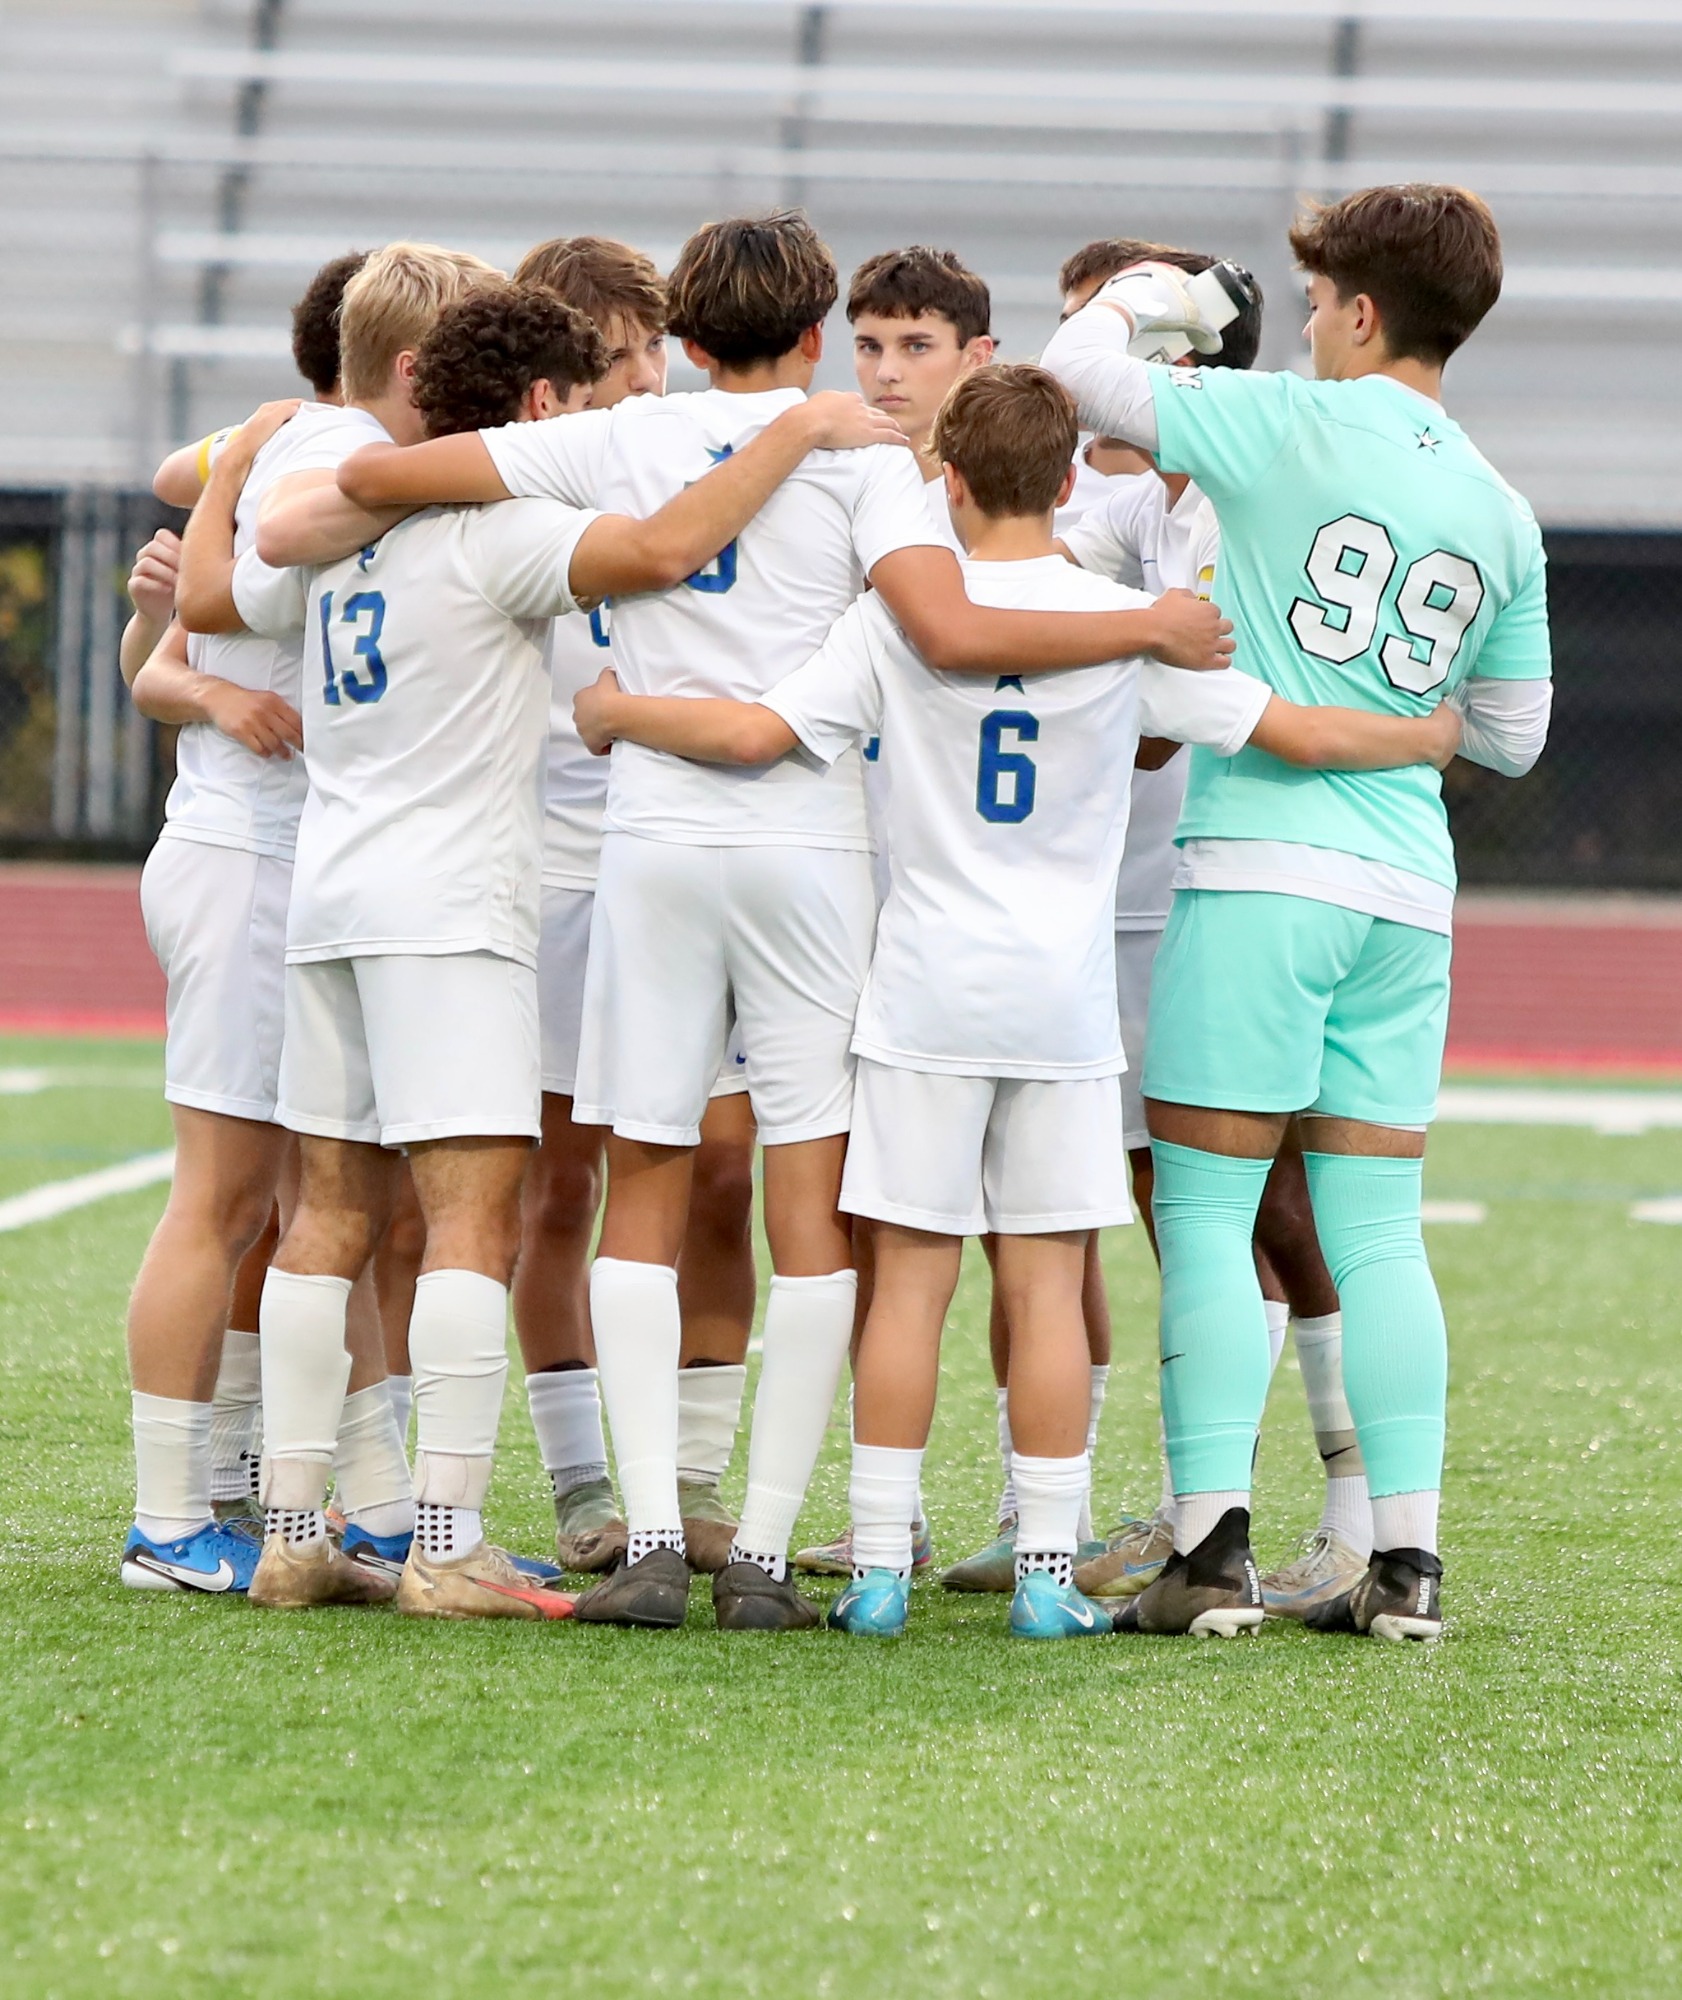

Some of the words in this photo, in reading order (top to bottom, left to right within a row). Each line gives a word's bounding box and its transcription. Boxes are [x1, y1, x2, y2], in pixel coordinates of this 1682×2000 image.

[319, 590, 388, 706] 13
[1286, 512, 1485, 697] 99
[975, 709, 1040, 824] 6
[1246, 1567, 1260, 1604] PREDATOR
[1415, 1576, 1430, 1615] PREDATOR
